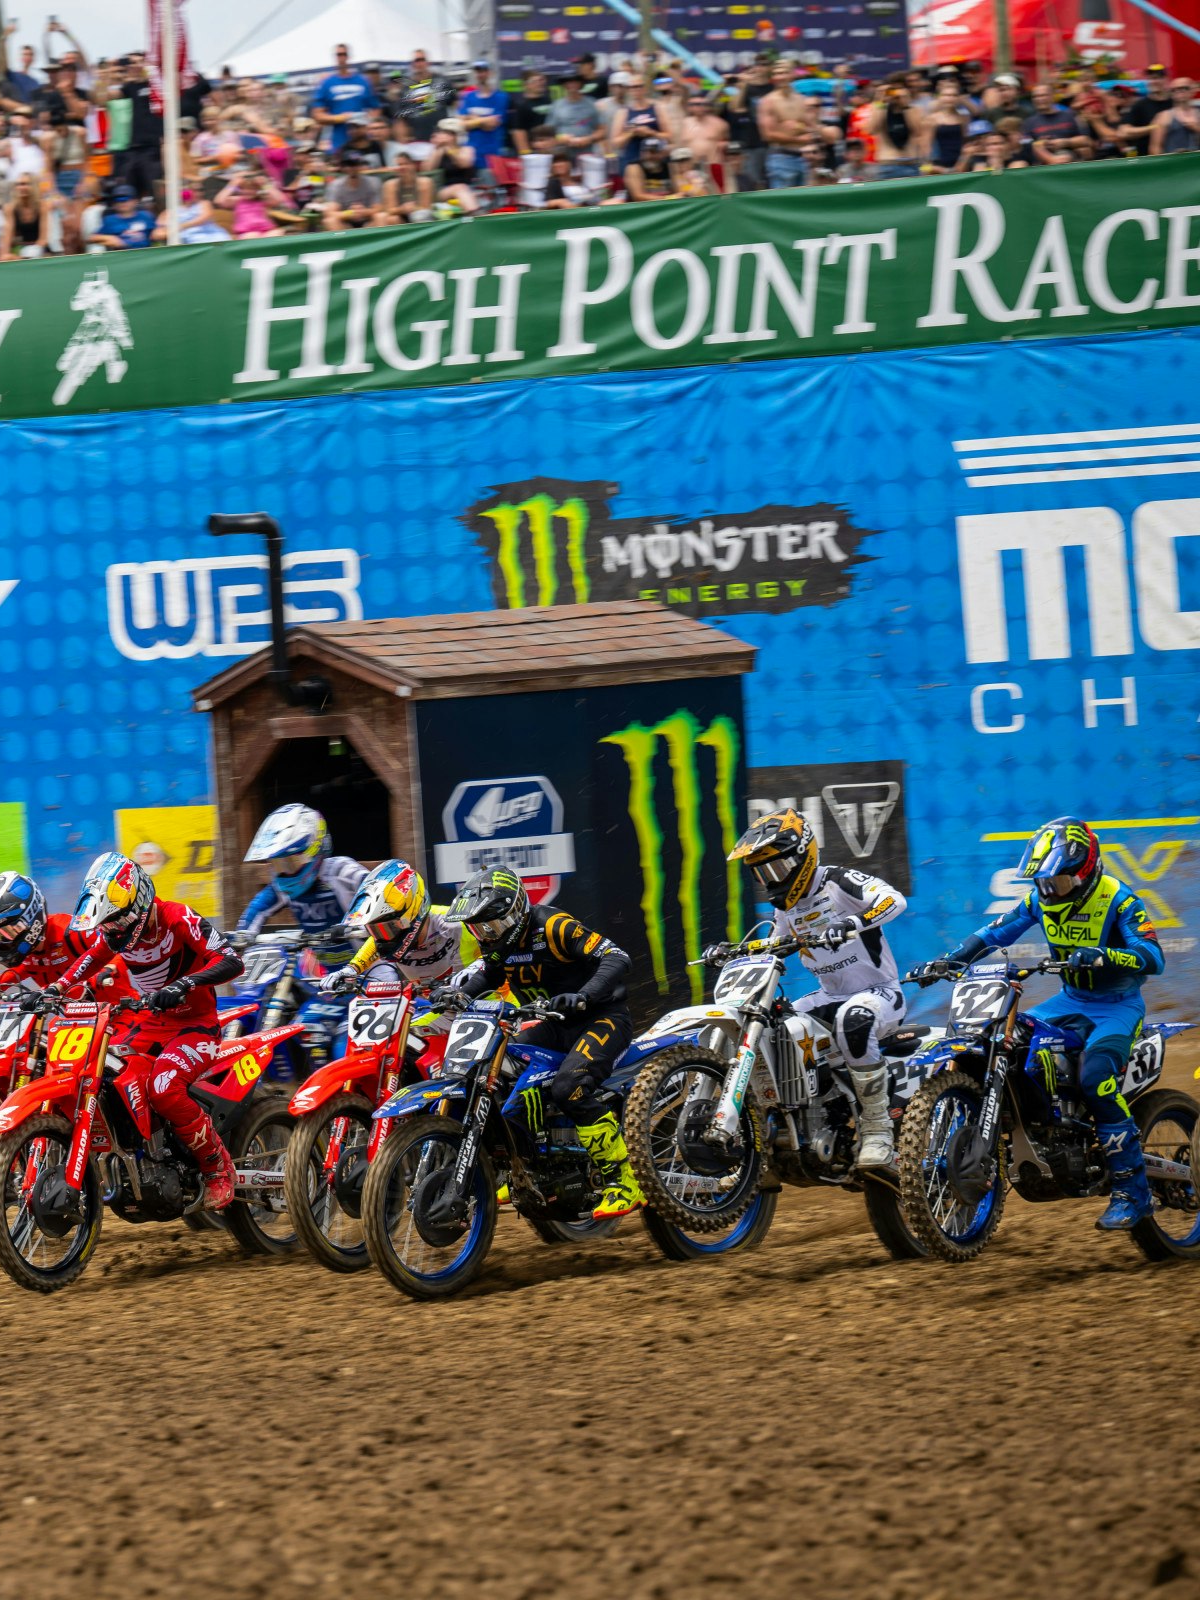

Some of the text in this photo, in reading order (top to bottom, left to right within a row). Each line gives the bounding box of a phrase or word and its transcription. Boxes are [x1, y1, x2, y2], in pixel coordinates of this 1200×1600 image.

[233, 250, 530, 384] HIGH
[547, 227, 897, 359] POINT
[601, 520, 848, 580] MONSTER
[106, 547, 363, 661] WPS
[639, 578, 808, 606] ENERGY
[990, 840, 1186, 929] SX
[864, 896, 896, 921] ROCKSTAR
[504, 964, 543, 985] FLY
[512, 953, 533, 963] YAMAHA
[812, 954, 859, 976] Husqvarna
[716, 968, 768, 999] 24
[952, 981, 1008, 1021] 32
[352, 1008, 394, 1041] 96
[850, 1007, 874, 1018] FLY
[49, 1027, 95, 1062] 18
[216, 1045, 247, 1060] HONDA
[448, 1020, 488, 1058] 2
[576, 1017, 616, 1061] FLY
[232, 1053, 262, 1087] 18
[736, 1053, 754, 1092] MOTOREX
[1129, 1042, 1162, 1084] 32
[982, 1088, 997, 1140] DUNLOP
[72, 1128, 88, 1181] DUNLOP
[456, 1131, 475, 1184] DUNLOP
